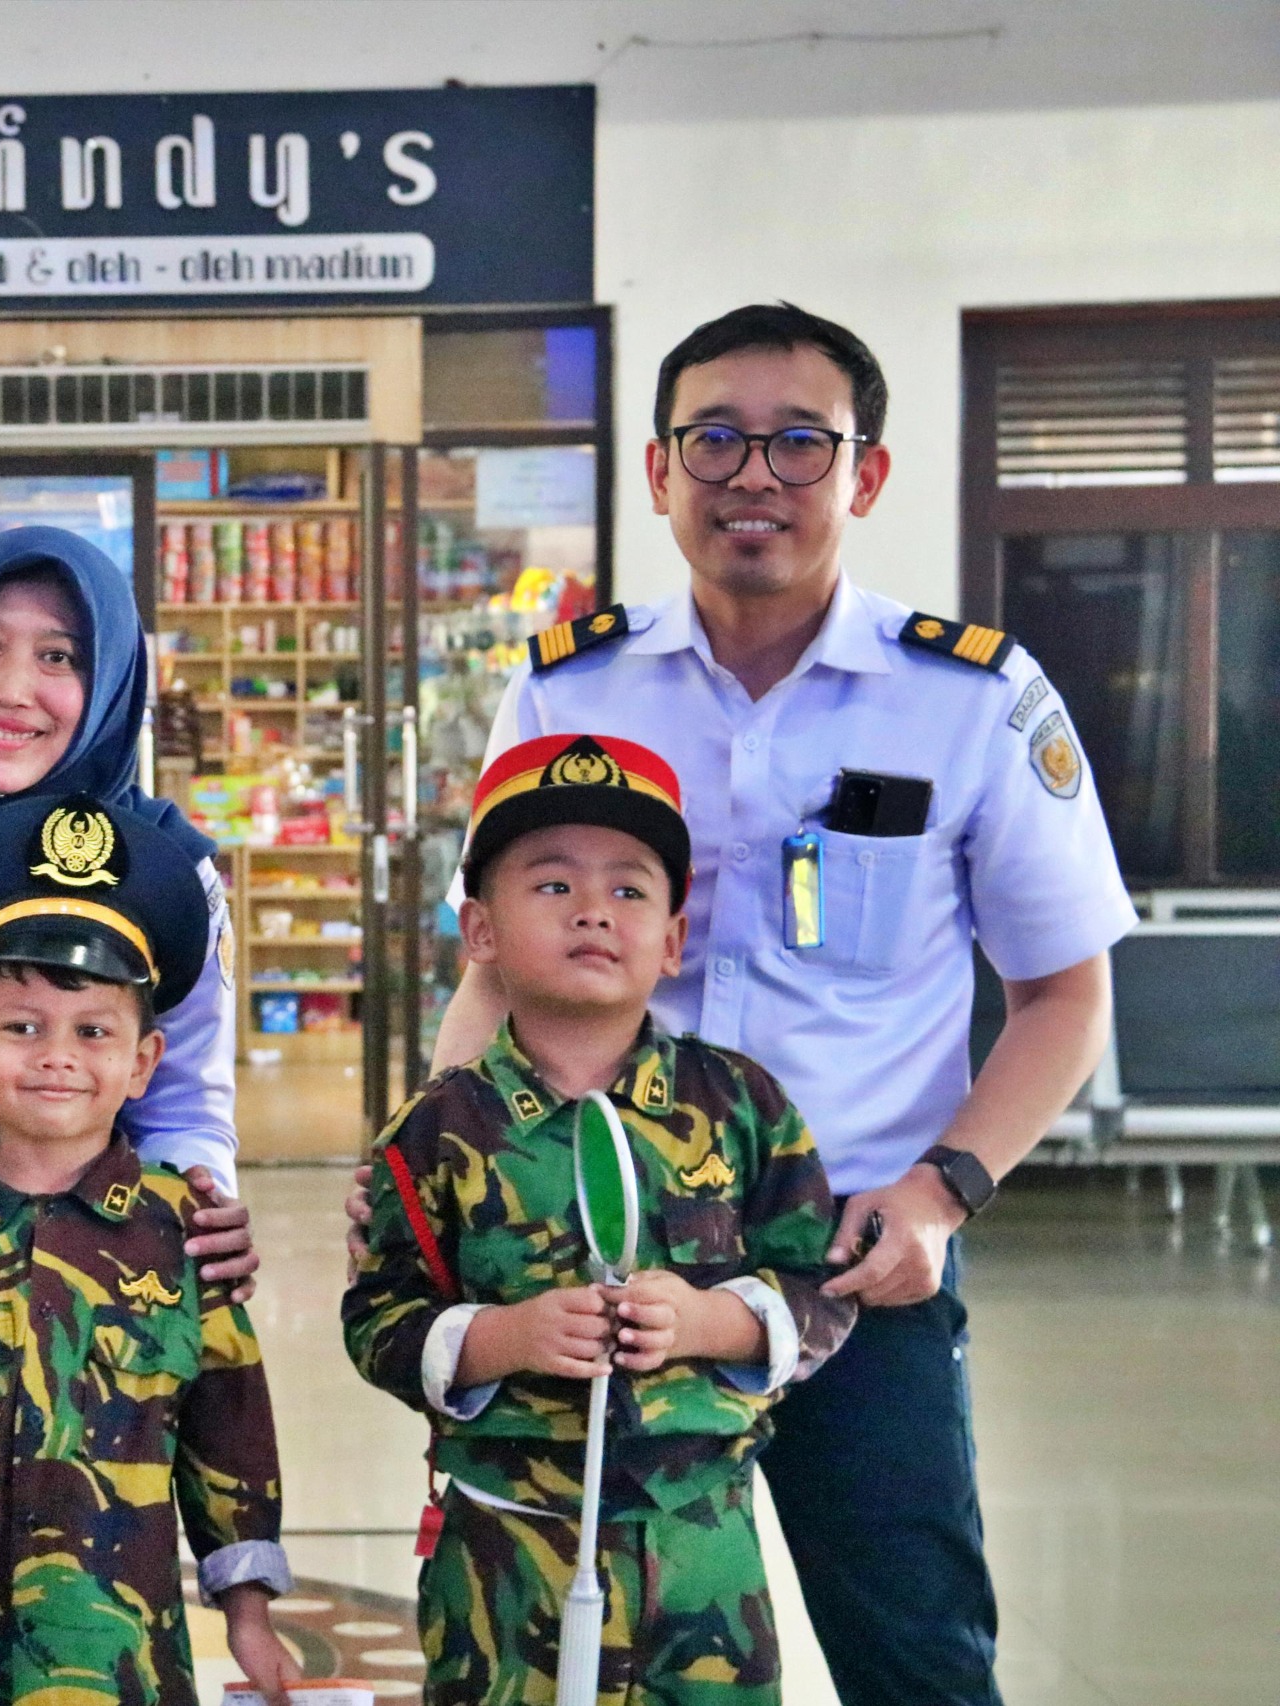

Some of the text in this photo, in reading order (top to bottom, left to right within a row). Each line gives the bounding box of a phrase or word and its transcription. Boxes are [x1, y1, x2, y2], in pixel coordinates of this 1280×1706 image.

[26, 248, 54, 285] &
[67, 251, 141, 283] oleh
[180, 249, 255, 282] oleh
[265, 243, 414, 280] madiun
